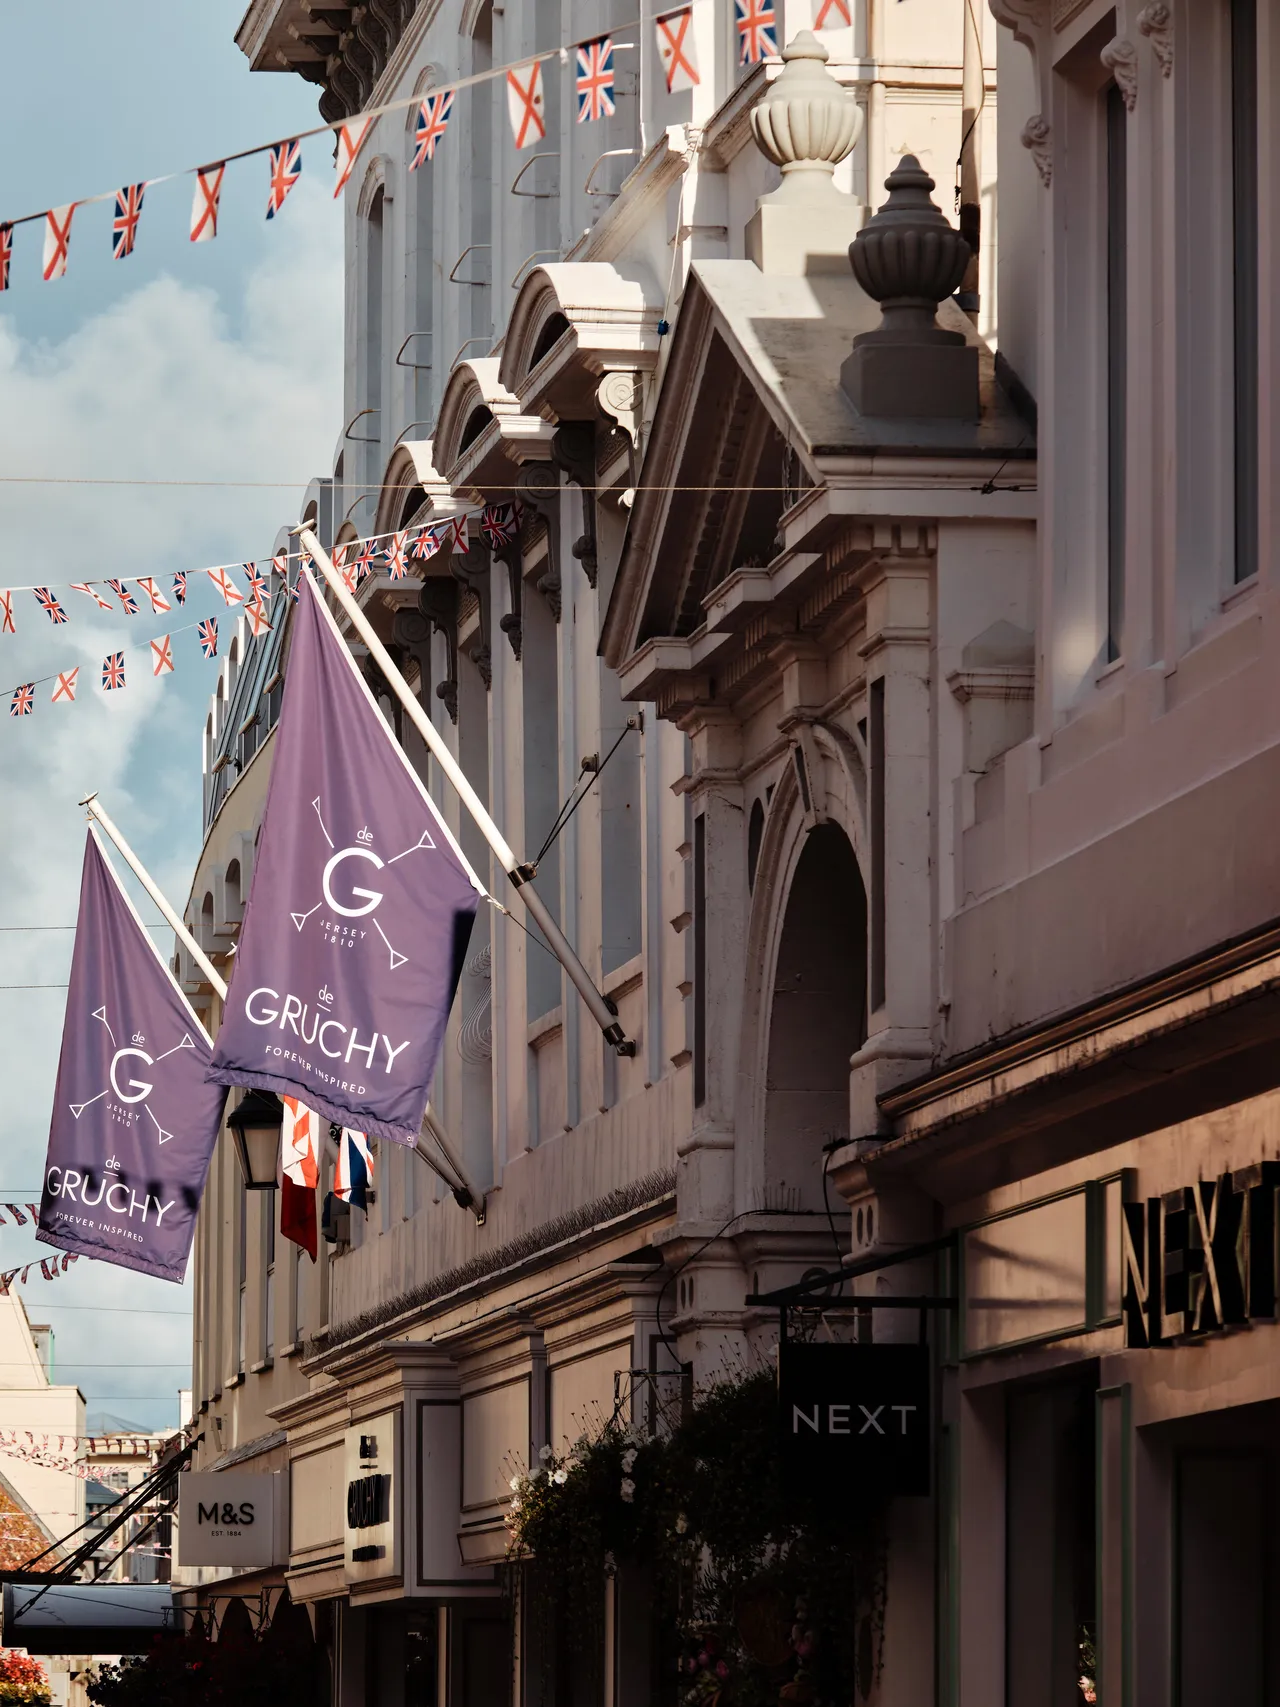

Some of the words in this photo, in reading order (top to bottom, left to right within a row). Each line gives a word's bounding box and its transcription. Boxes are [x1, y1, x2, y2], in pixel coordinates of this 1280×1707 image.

[356, 825, 374, 842] de
[322, 847, 385, 918] G
[323, 933, 354, 948] 1810
[318, 984, 334, 1005] de
[131, 1030, 146, 1044] de
[245, 987, 411, 1074] GRUCHY
[110, 1047, 154, 1104] G
[265, 1045, 312, 1072] FOREVER
[314, 1067, 366, 1095] INSPIRED
[106, 1103, 140, 1121] JERSEY
[112, 1114, 131, 1127] 1810
[105, 1154, 121, 1171] de
[47, 1166, 176, 1227] GRUCHY
[55, 1211, 95, 1228] FOREVER
[98, 1223, 144, 1243] INSPIRED
[1122, 1161, 1277, 1348] NEXT
[792, 1403, 917, 1435] NEXT
[198, 1502, 255, 1526] M&S
